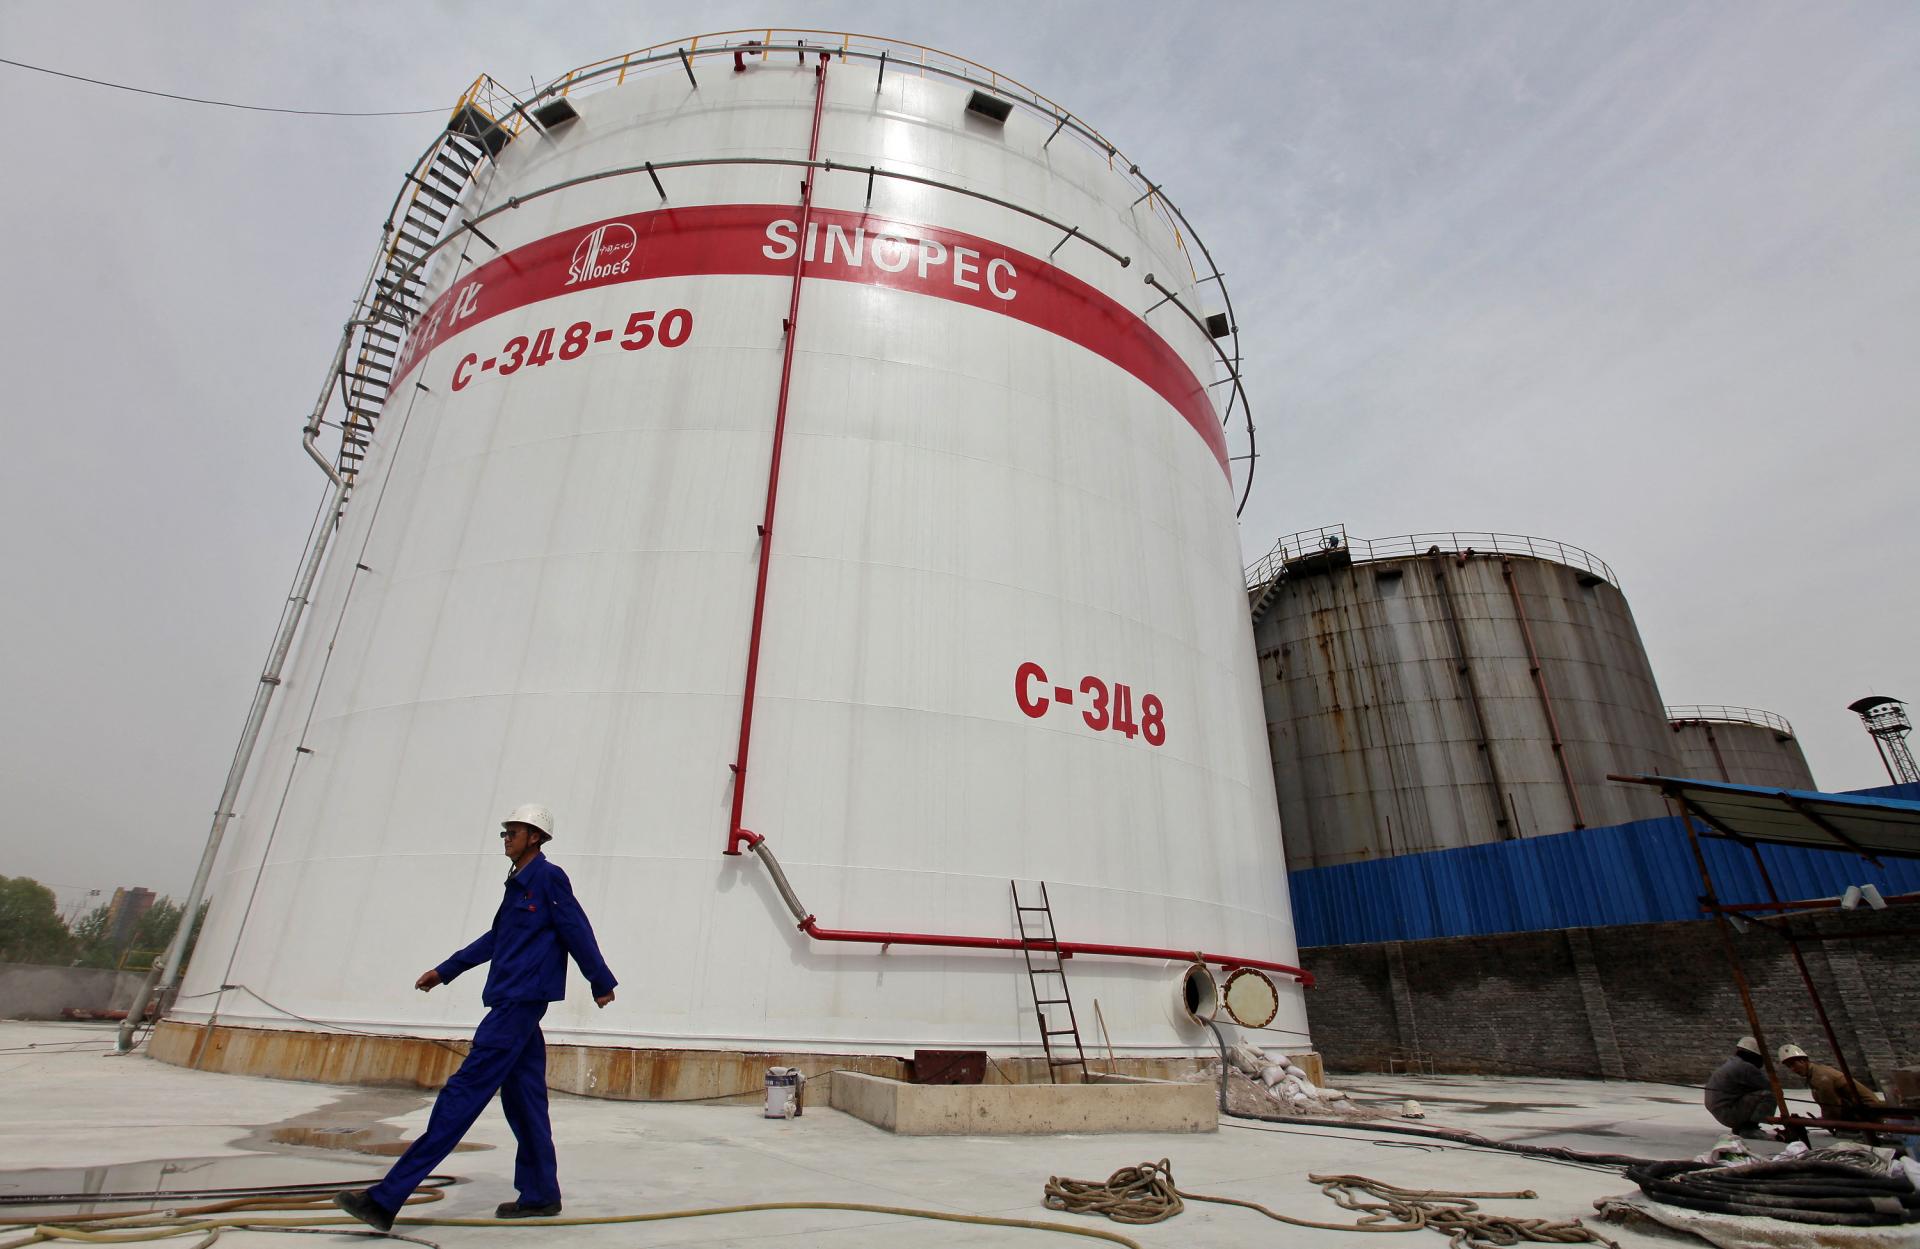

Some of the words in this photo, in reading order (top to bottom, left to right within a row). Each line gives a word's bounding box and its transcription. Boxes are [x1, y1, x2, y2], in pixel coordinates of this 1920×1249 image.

[762, 219, 1017, 300] SINOPEC
[451, 308, 693, 391] C-348-50
[1014, 661, 1166, 747] C-348
